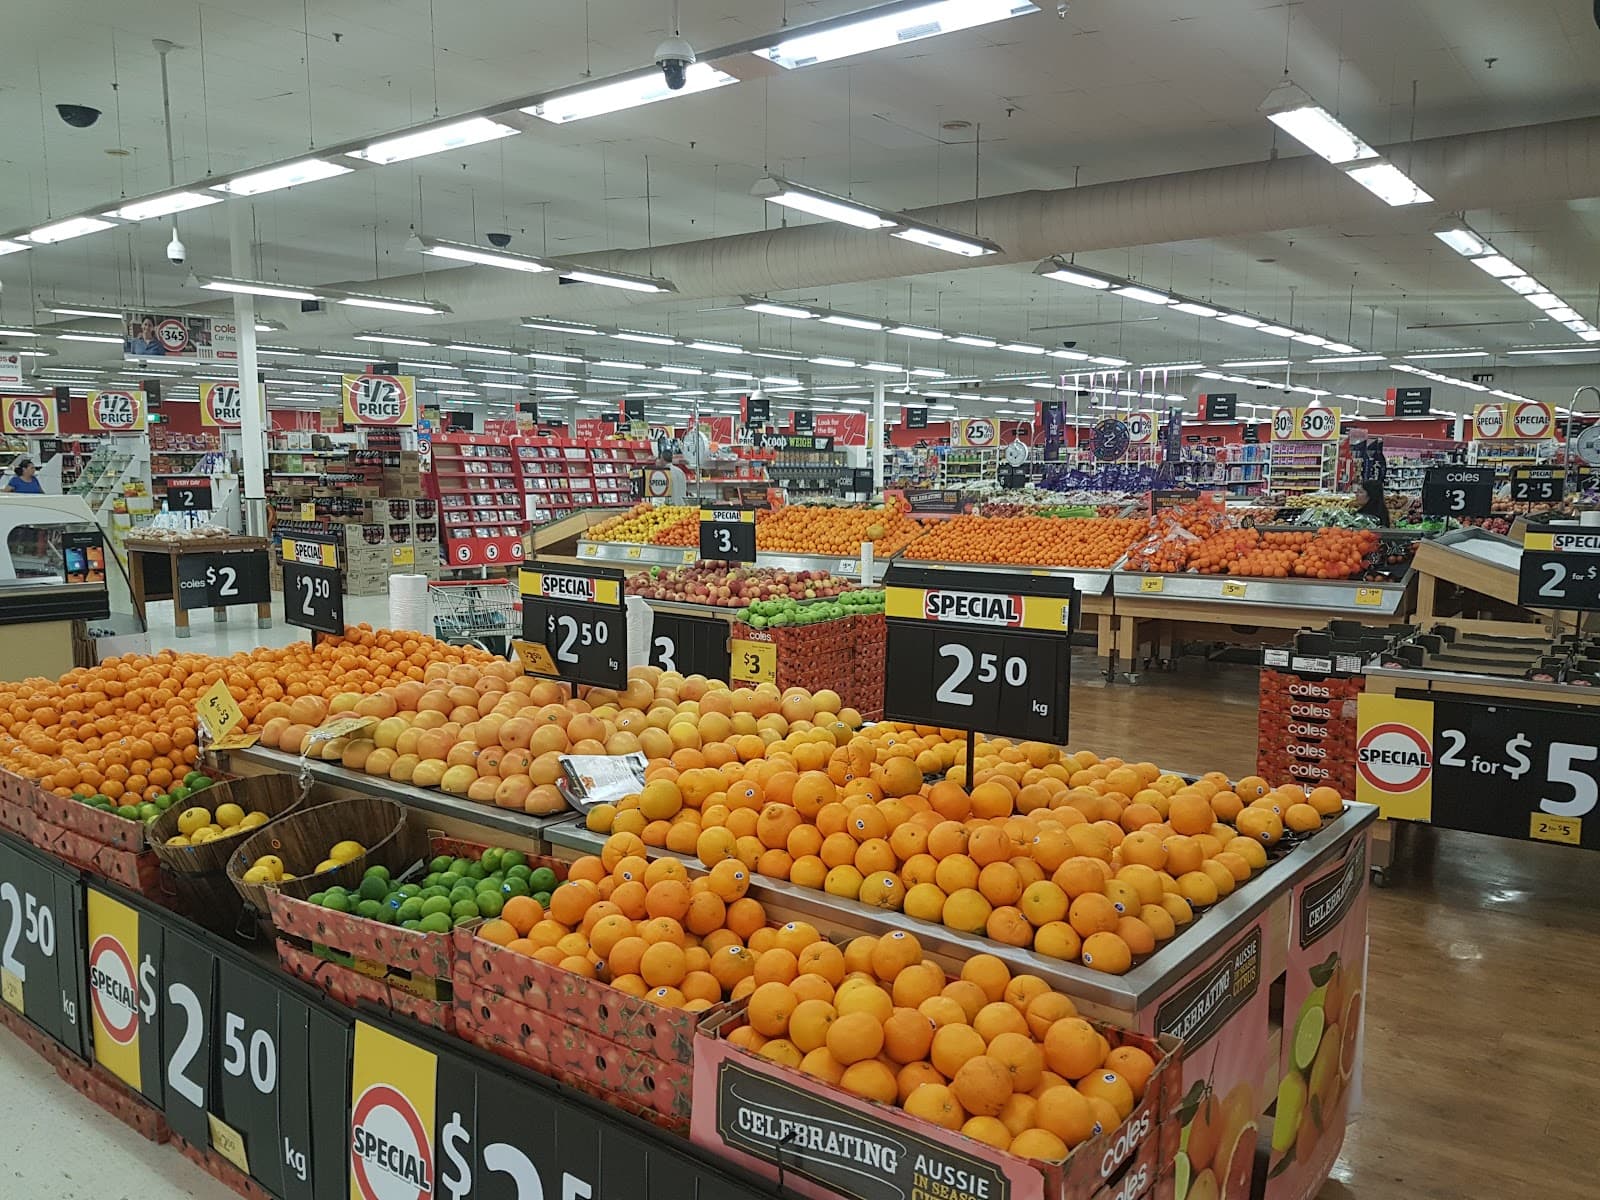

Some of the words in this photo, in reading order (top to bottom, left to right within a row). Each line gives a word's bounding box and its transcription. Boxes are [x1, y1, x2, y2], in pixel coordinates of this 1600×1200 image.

[214, 324, 236, 333] cole
[360, 378, 398, 402] 1/2
[15, 401, 42, 418] 1/2
[101, 394, 130, 412] 1/2
[359, 402, 399, 416] PRICE
[101, 413, 133, 423] PRICE
[215, 408, 241, 418] PRIC
[1478, 417, 1503, 425] SPECIAL
[1515, 416, 1549, 424] SPECIAL
[15, 418, 44, 427] PRICE
[1302, 415, 1335, 430] 30%
[760, 434, 787, 451] Scoop
[1447, 472, 1479, 482] coles
[1517, 483, 1528, 498] 2
[179, 491, 194, 507] $2
[713, 511, 740, 519] SPECIAL
[1555, 535, 1600, 548] SPECI
[295, 543, 322, 559] SPECIAL
[180, 578, 205, 589] coles
[206, 566, 239, 596] $2
[543, 575, 593, 597] SPECIAL
[1538, 562, 1567, 597] 2
[927, 594, 1018, 621] SPECIAL
[655, 636, 676, 672] 3
[608, 658, 619, 671] kg
[1289, 683, 1330, 697] coles
[1032, 700, 1048, 716] kg
[1290, 704, 1331, 718] coles
[1287, 723, 1328, 737] coles
[1286, 744, 1327, 757] coles
[1359, 748, 1430, 767] SPECIAL
[1439, 729, 1467, 767] 2
[1471, 755, 1500, 775] for
[1289, 764, 1329, 778] coles
[1539, 823, 1548, 832] 2
[91, 966, 138, 1013] SPECIAL
[63, 990, 76, 1025] kg
[1171, 969, 1230, 1039] ELEBRATING
[738, 1107, 898, 1174] CELEBRATING
[1101, 1110, 1150, 1178] coles
[284, 1138, 307, 1181] kg
[354, 1127, 432, 1191] SPECIAL
[913, 1172, 928, 1189] IN
[914, 1154, 990, 1199] AUSSIE
